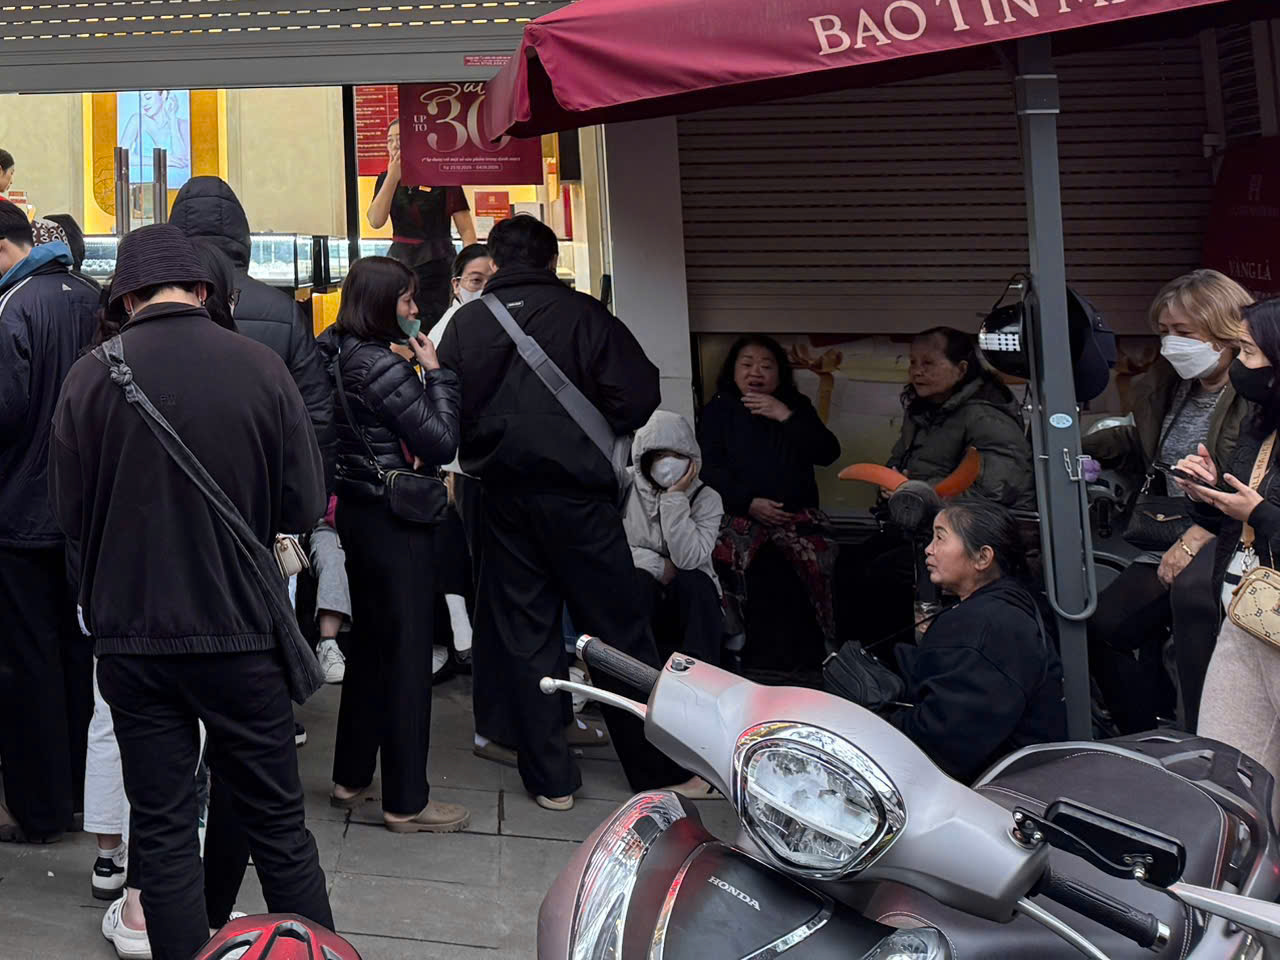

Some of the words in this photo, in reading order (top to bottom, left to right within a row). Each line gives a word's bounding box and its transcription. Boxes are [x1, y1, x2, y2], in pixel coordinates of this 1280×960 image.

[808, 0, 927, 56] BAO
[413, 123, 427, 132] TO
[414, 115, 427, 123] UP
[707, 876, 761, 911] HONDA
